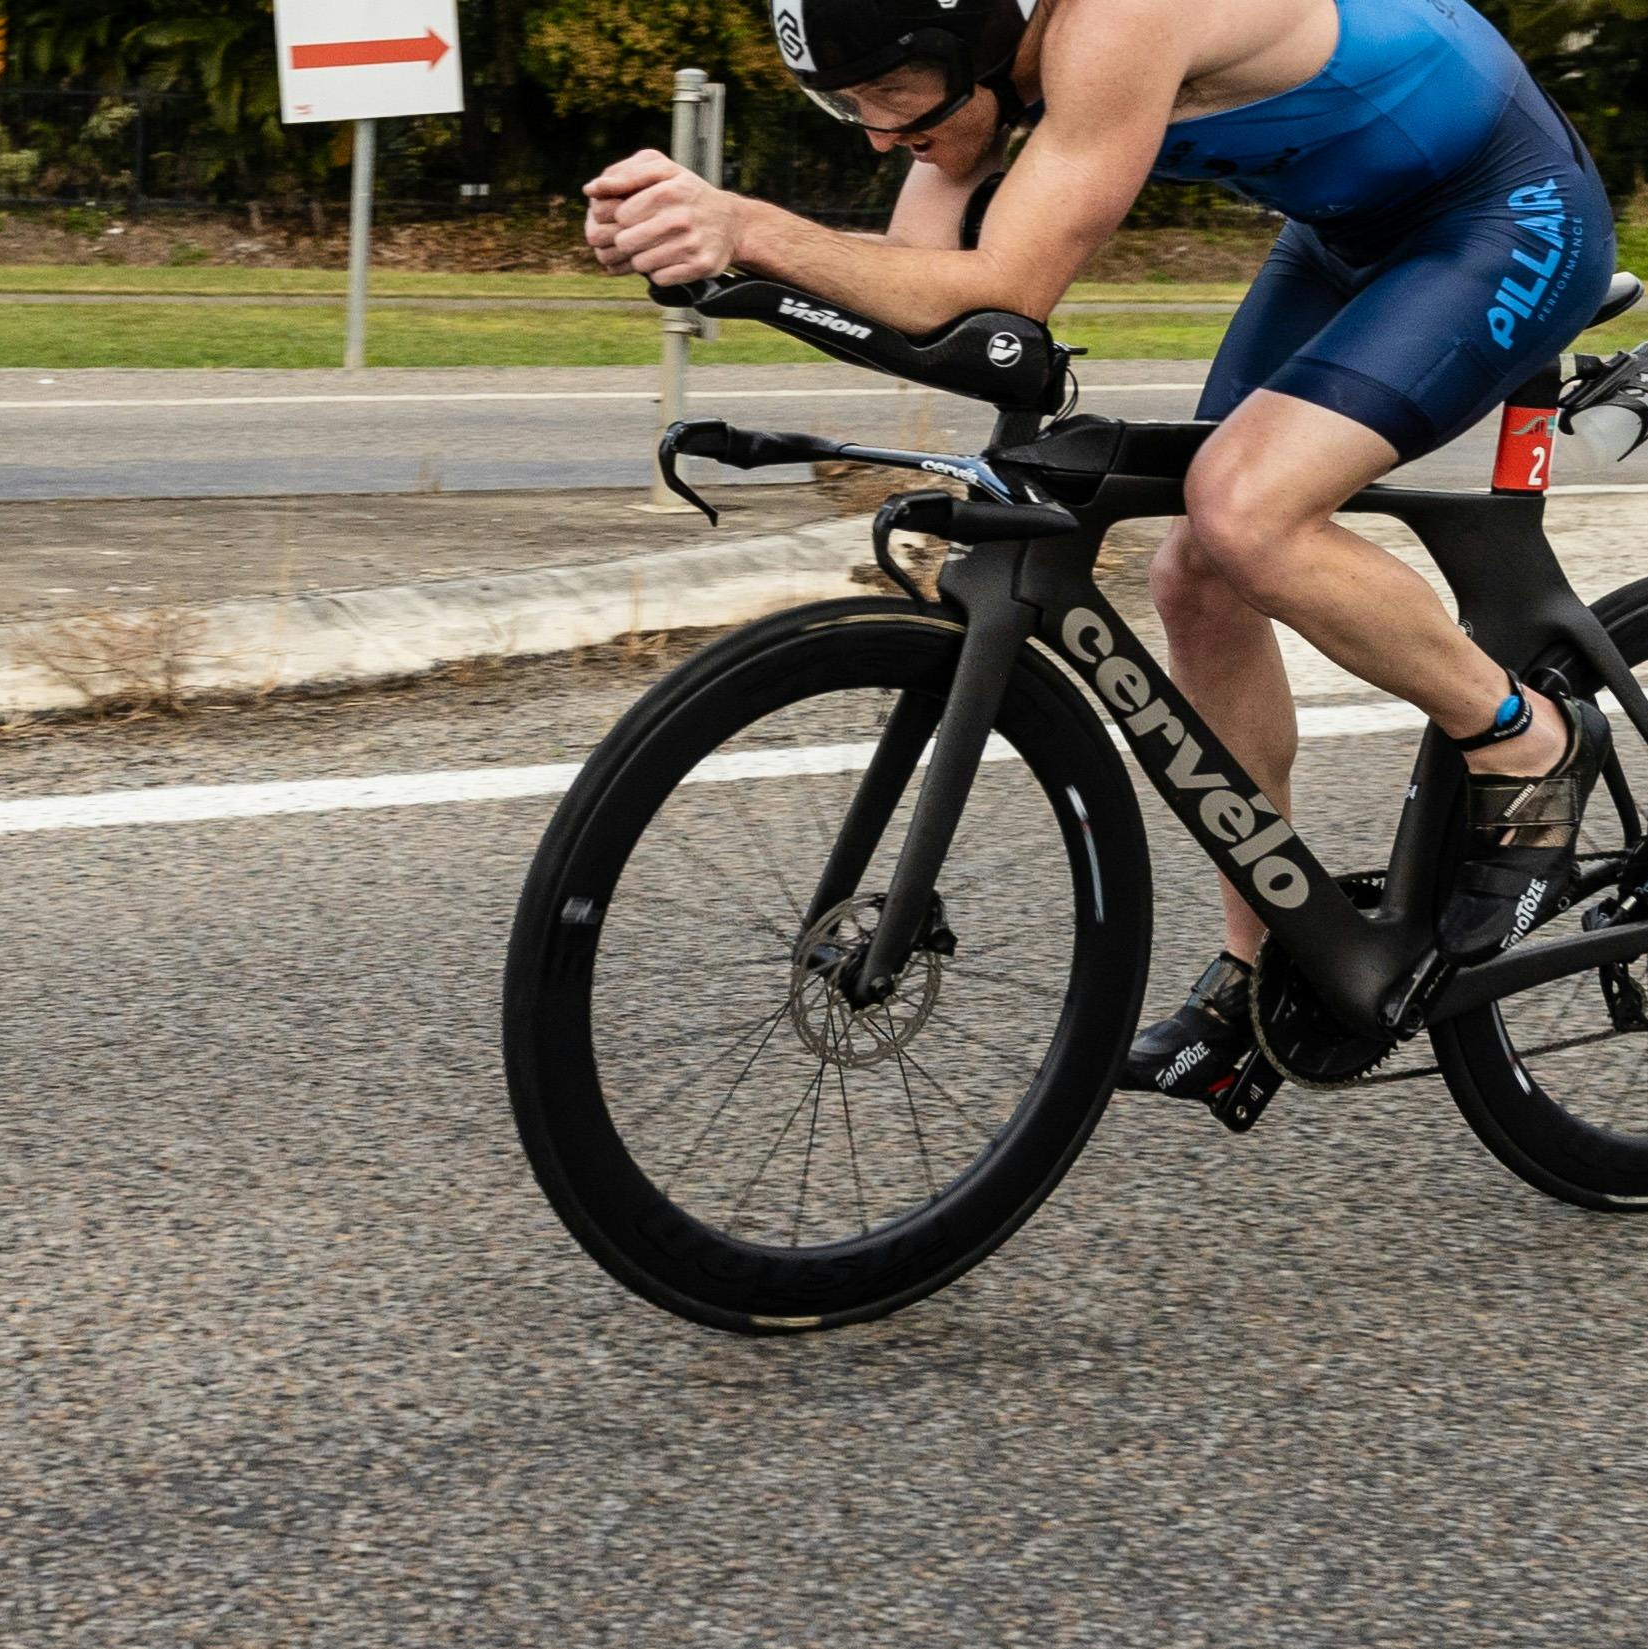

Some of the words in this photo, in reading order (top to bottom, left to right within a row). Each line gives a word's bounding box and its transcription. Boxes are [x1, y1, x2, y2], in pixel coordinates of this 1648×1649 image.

[1486, 177, 1567, 350] PILLAR
[1536, 215, 1584, 323] PERFORMANCE
[1527, 445, 1546, 487] 2
